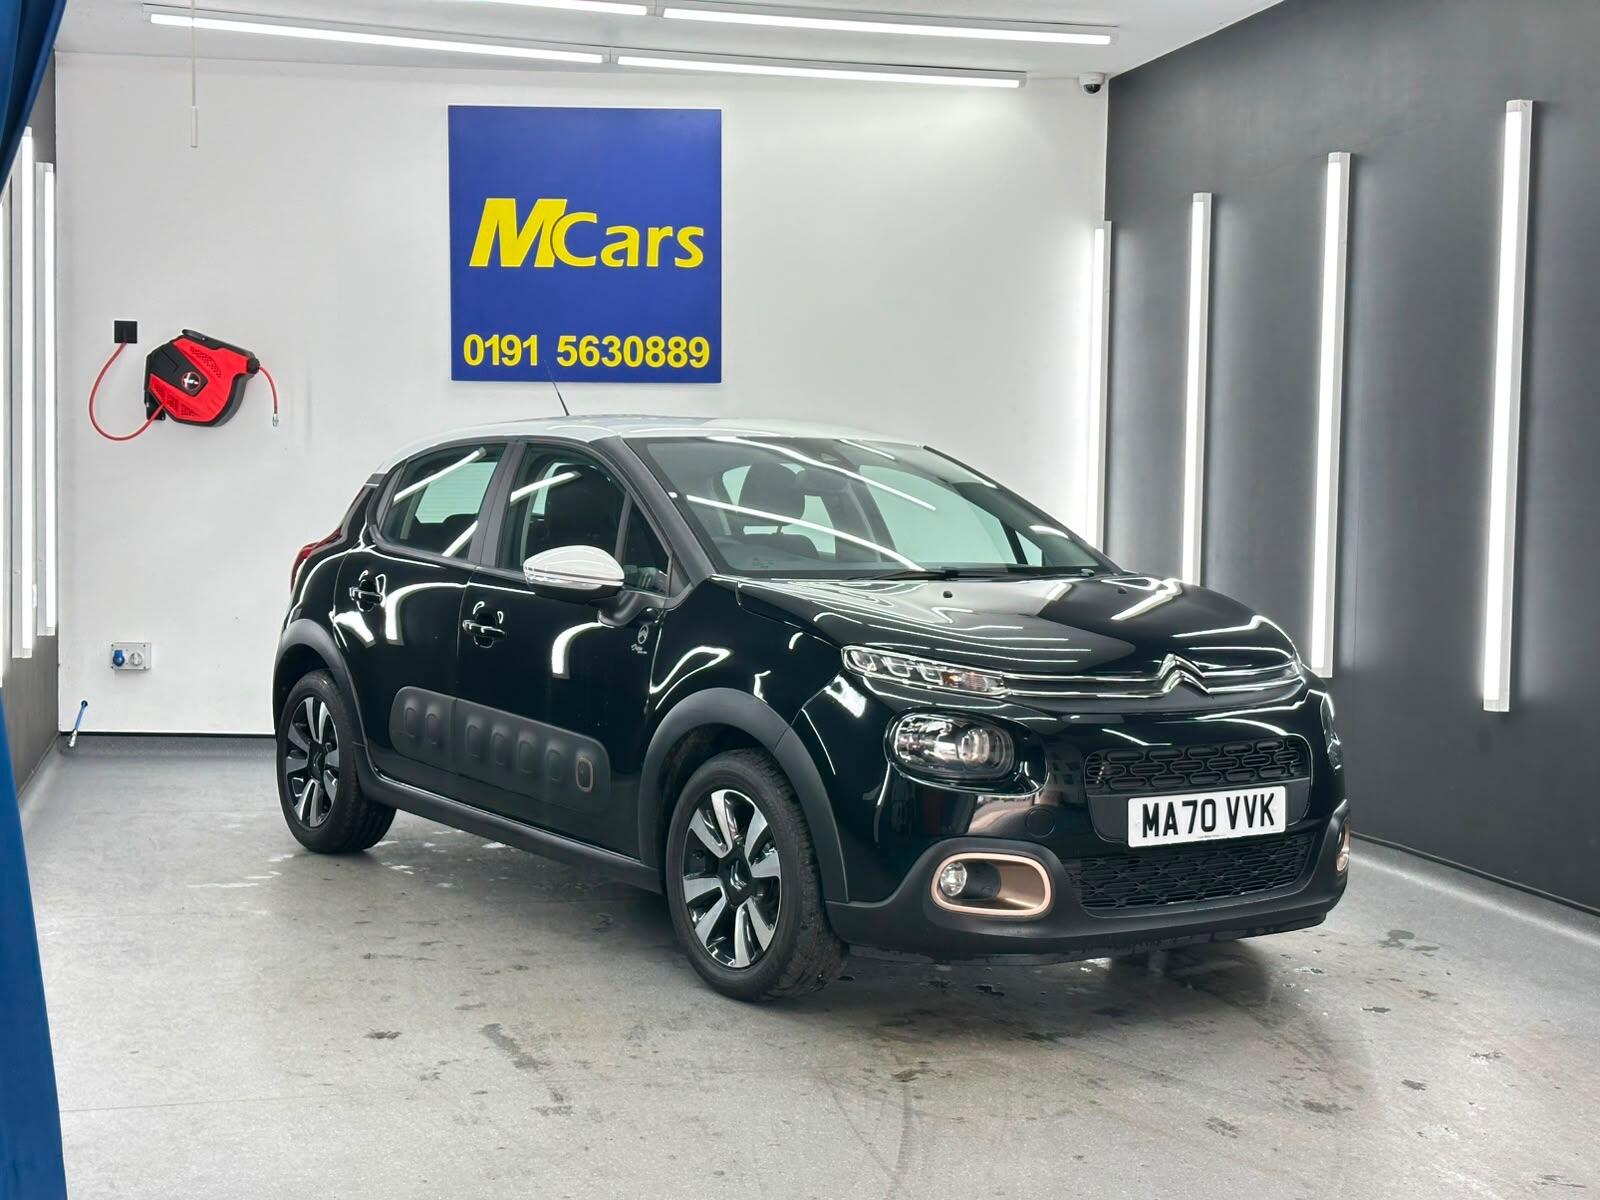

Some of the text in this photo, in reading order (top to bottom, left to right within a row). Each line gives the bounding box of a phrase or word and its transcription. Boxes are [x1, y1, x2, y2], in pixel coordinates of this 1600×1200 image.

[463, 334, 710, 368] 0191 5630889
[1142, 793, 1275, 838] MA70 VVK
